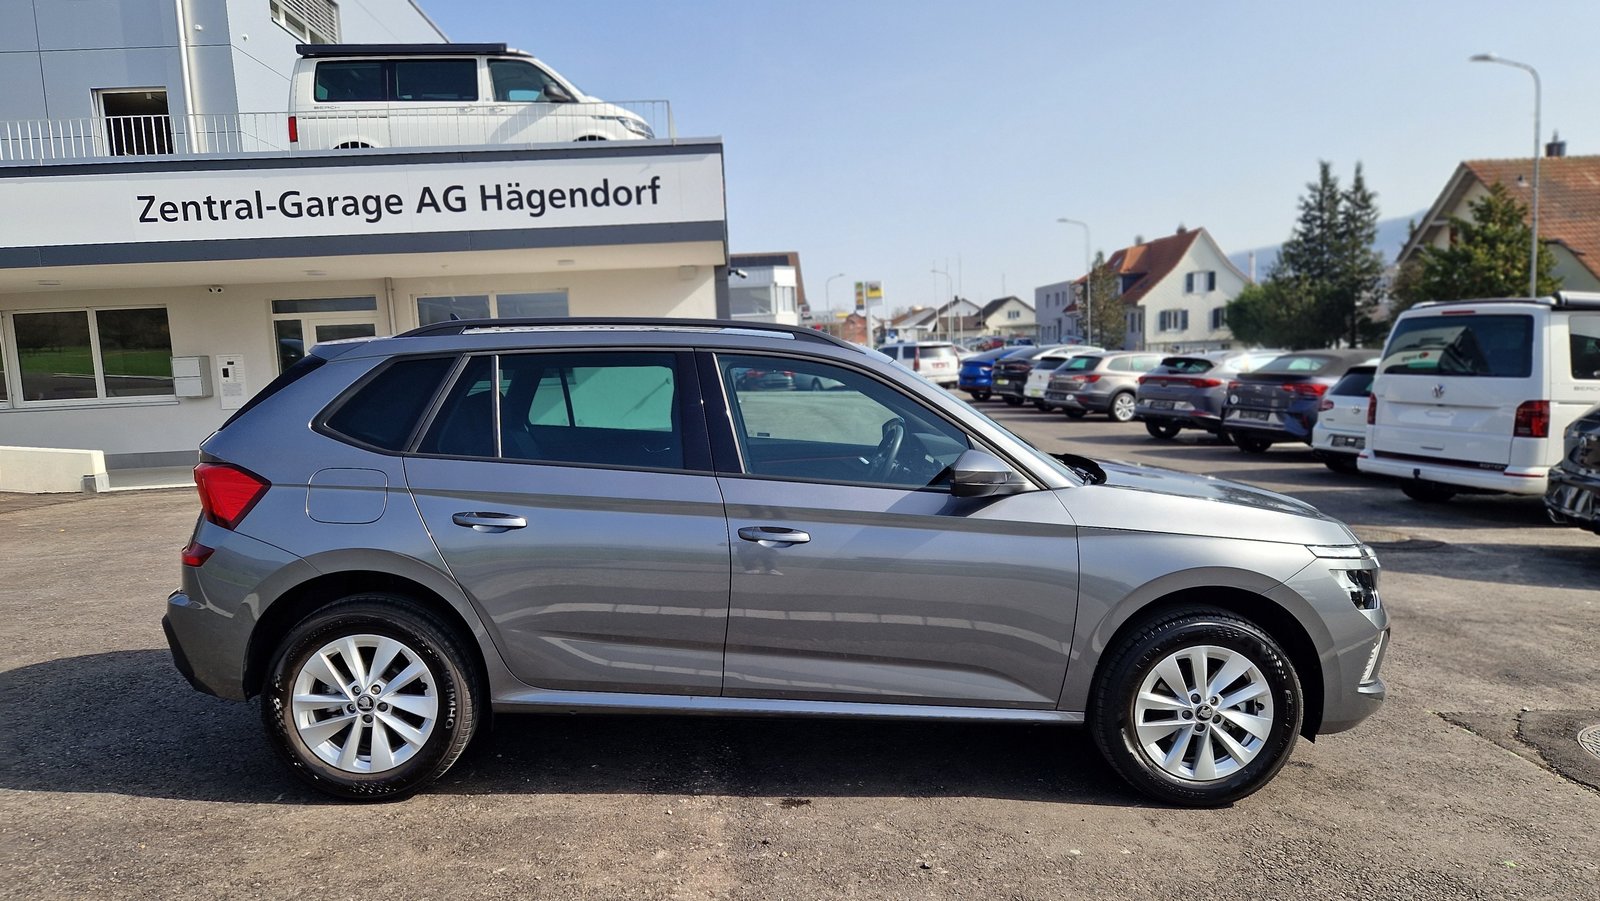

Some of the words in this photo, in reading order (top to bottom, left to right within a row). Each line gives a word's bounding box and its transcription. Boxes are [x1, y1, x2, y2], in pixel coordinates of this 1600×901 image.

[137, 191, 404, 223] Zentral-Garage
[416, 186, 467, 213] AG
[480, 176, 661, 217] Hägendorf
